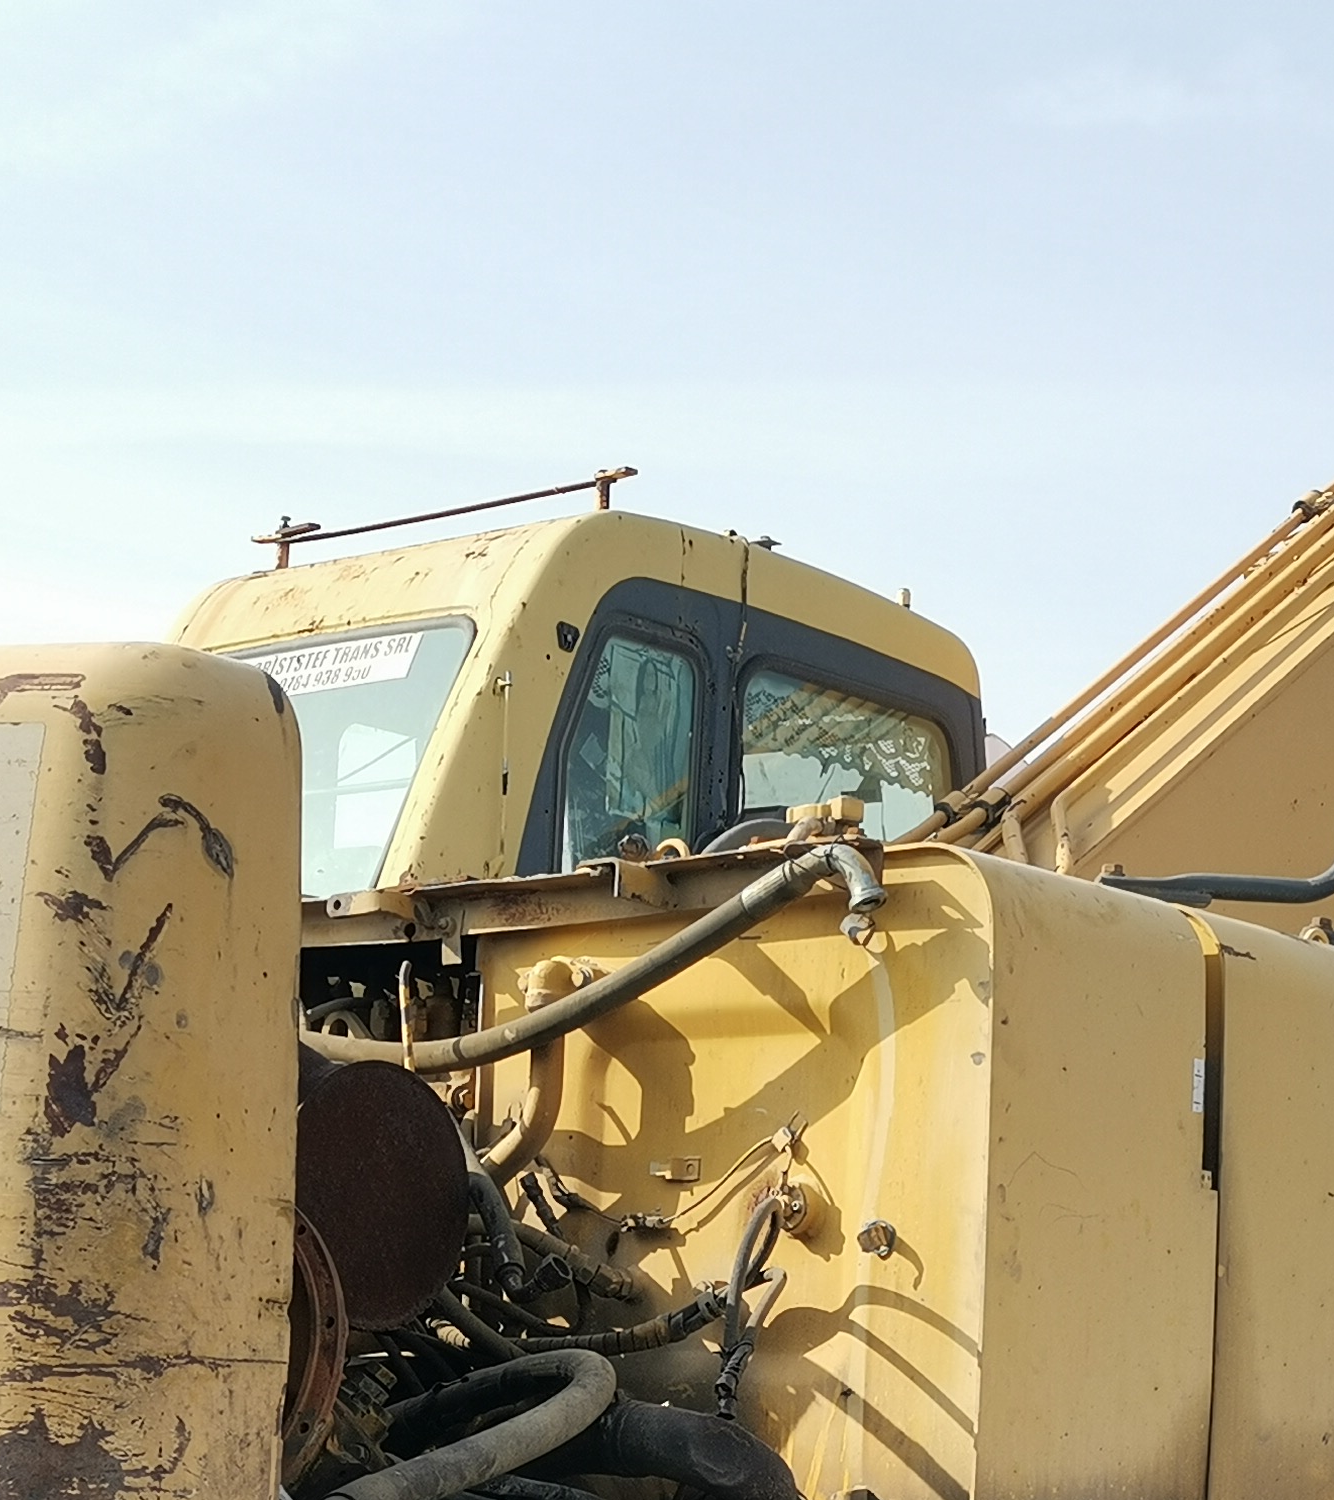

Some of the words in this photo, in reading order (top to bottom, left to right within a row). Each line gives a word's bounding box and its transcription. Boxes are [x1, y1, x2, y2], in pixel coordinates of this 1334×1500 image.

[332, 640, 383, 666] TRANS
[384, 635, 413, 656] SRL
[312, 668, 341, 687] 938
